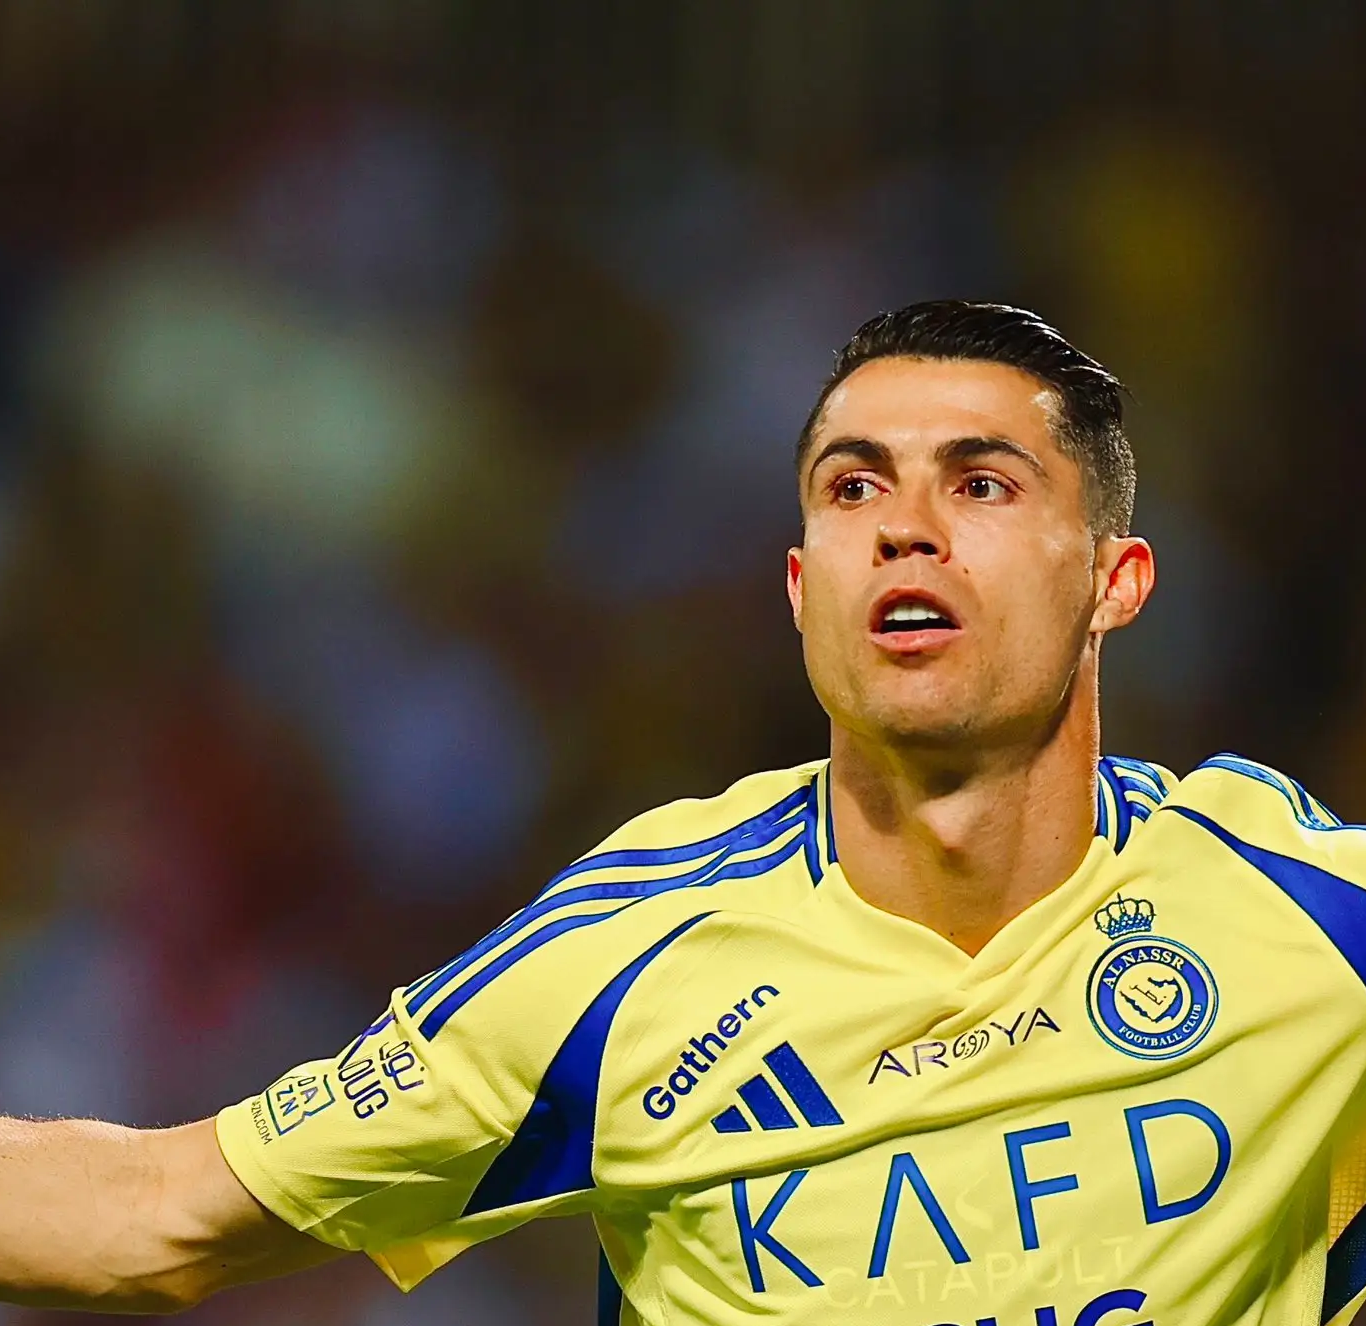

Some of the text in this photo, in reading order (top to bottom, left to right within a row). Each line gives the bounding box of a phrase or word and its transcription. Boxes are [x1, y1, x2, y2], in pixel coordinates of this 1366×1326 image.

[1102, 949, 1184, 989] AL NASSR
[1118, 1004, 1202, 1046] FOOTBALL CLUB
[642, 983, 781, 1121] Gathern
[251, 1096, 273, 1146] AZN.COM
[731, 1097, 1233, 1294] KAFD
